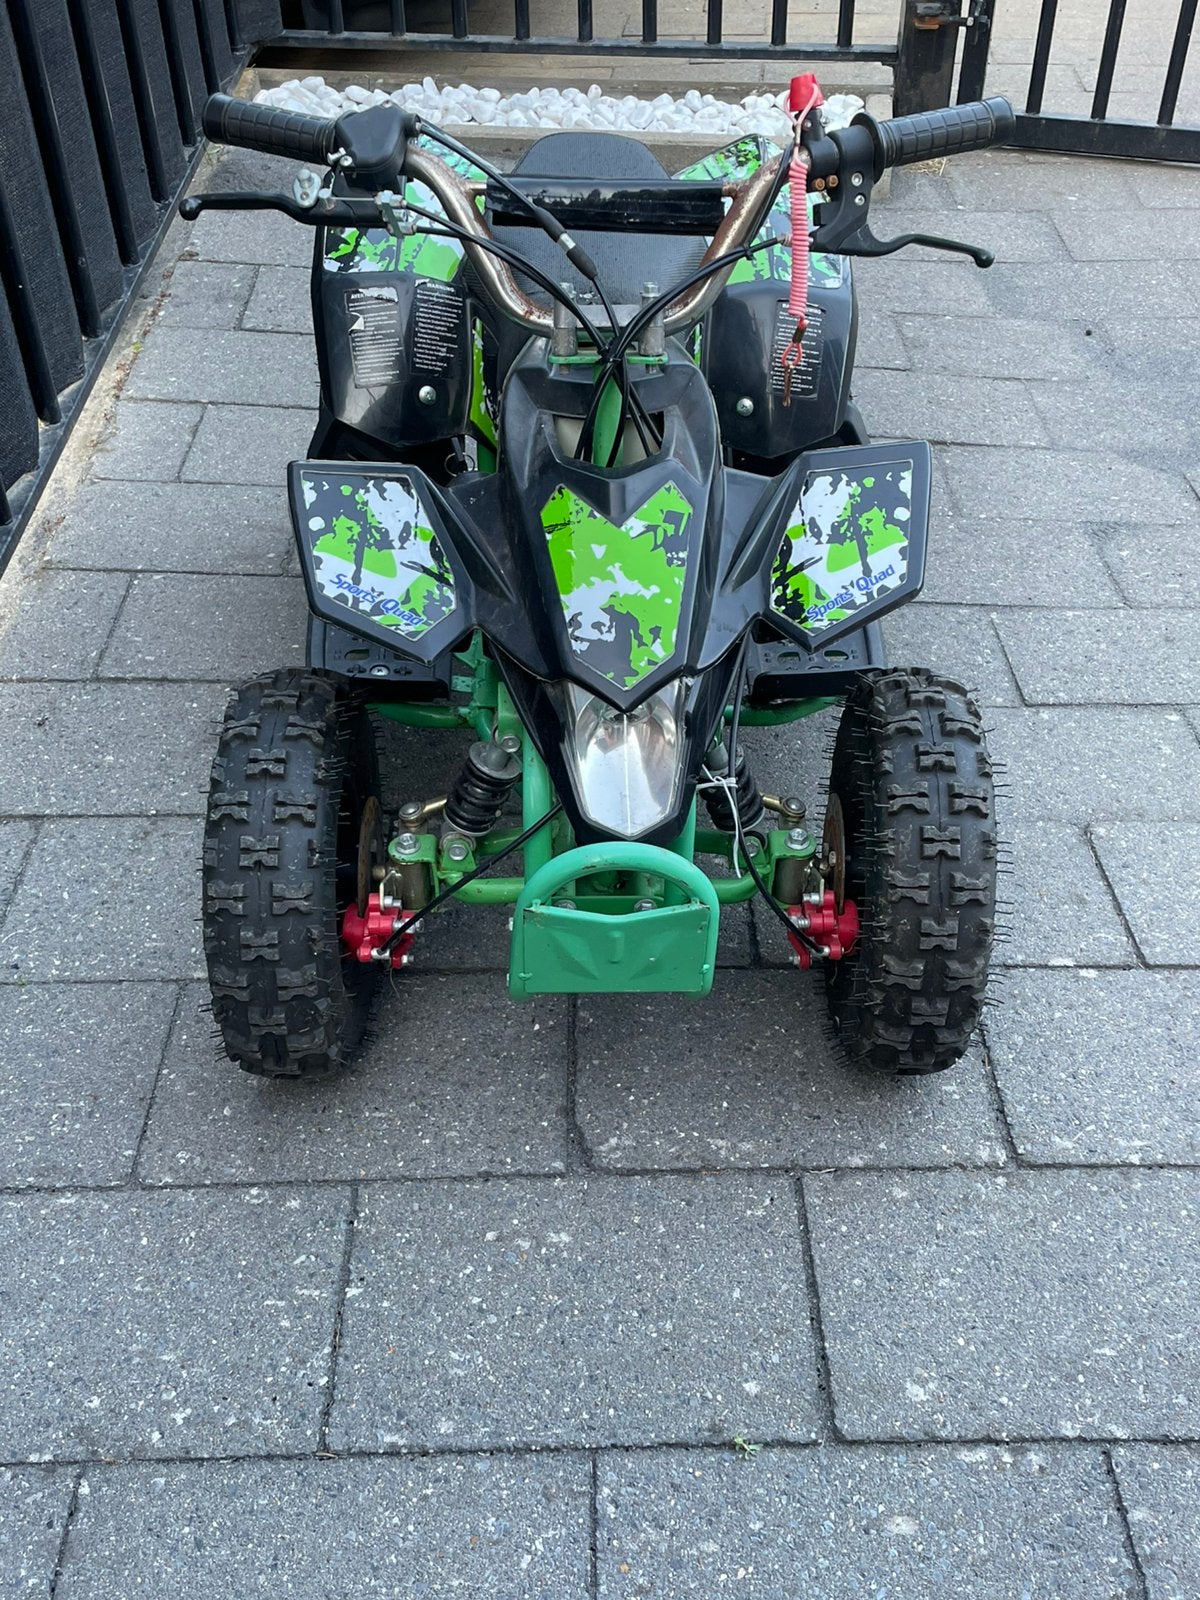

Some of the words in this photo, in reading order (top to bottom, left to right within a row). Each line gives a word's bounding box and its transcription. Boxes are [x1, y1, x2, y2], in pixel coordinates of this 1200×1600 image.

[329, 573, 378, 605] Sports
[381, 598, 425, 626] Quad
[806, 589, 854, 621] Sports
[855, 564, 896, 592] Quad
